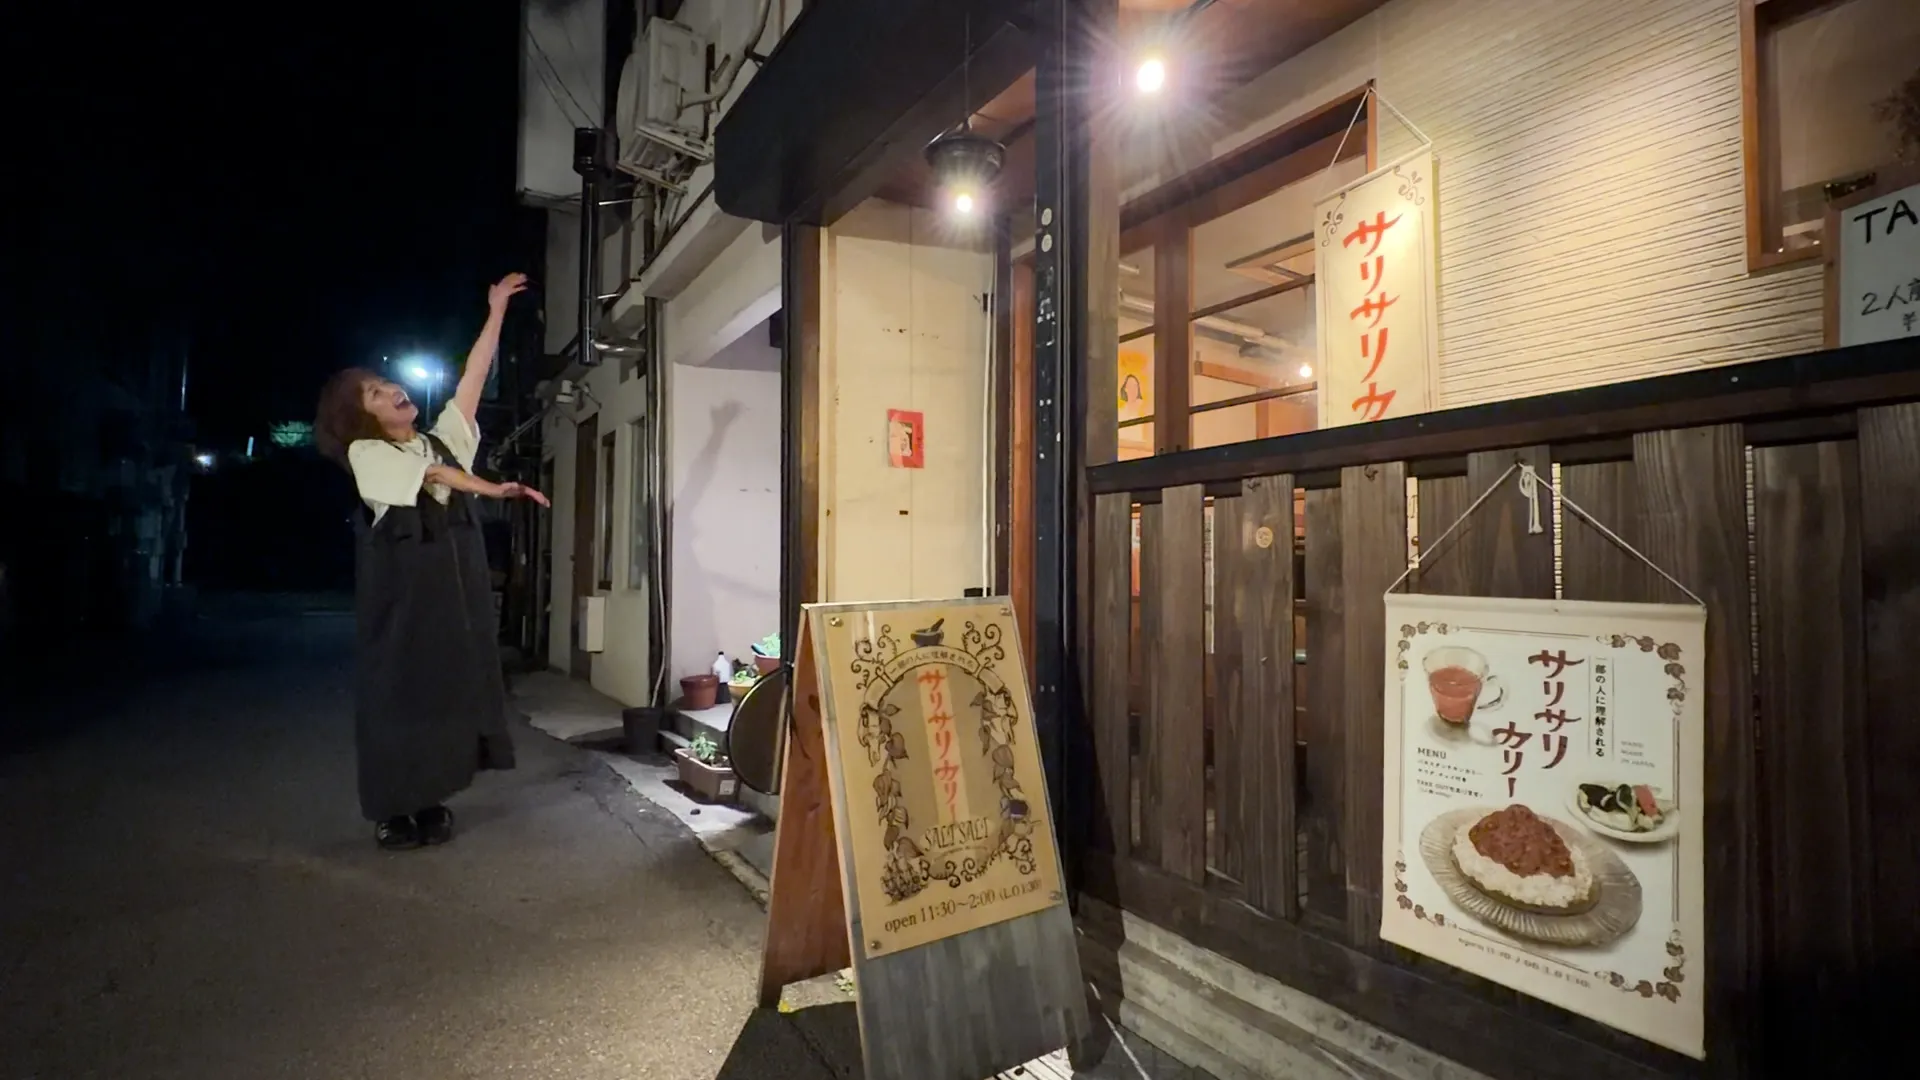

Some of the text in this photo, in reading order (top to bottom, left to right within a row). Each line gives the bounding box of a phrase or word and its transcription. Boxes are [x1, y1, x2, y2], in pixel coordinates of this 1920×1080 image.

[916, 669, 960, 823] サリサリカリー
[1528, 649, 1585, 769] サリサリ
[1595, 657, 1606, 757] 一部の人に理解される
[1417, 747, 1447, 759] MENU
[1492, 721, 1533, 798] カリー
[884, 914, 917, 933] open
